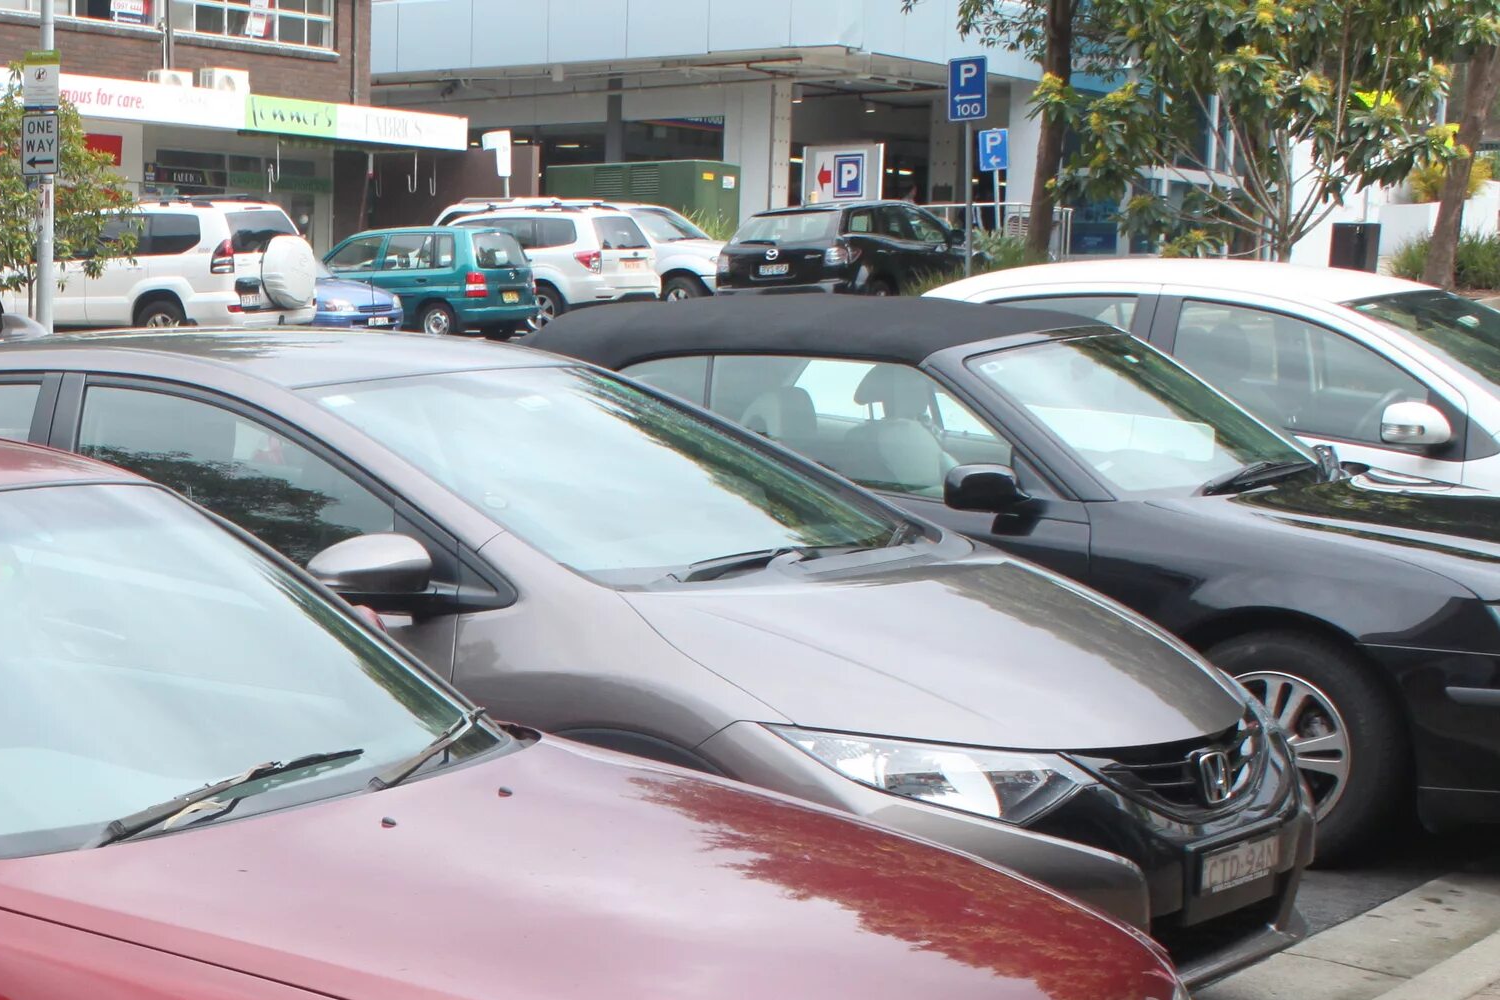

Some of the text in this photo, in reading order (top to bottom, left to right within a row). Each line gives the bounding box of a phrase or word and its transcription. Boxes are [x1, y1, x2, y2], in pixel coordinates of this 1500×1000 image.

[960, 64, 977, 87] P
[96, 88, 114, 106] for
[117, 93, 144, 109] care.
[957, 103, 980, 116] 100
[28, 120, 53, 134] ONE
[26, 139, 54, 152] WAY
[986, 134, 1002, 154] P
[841, 163, 858, 189] P
